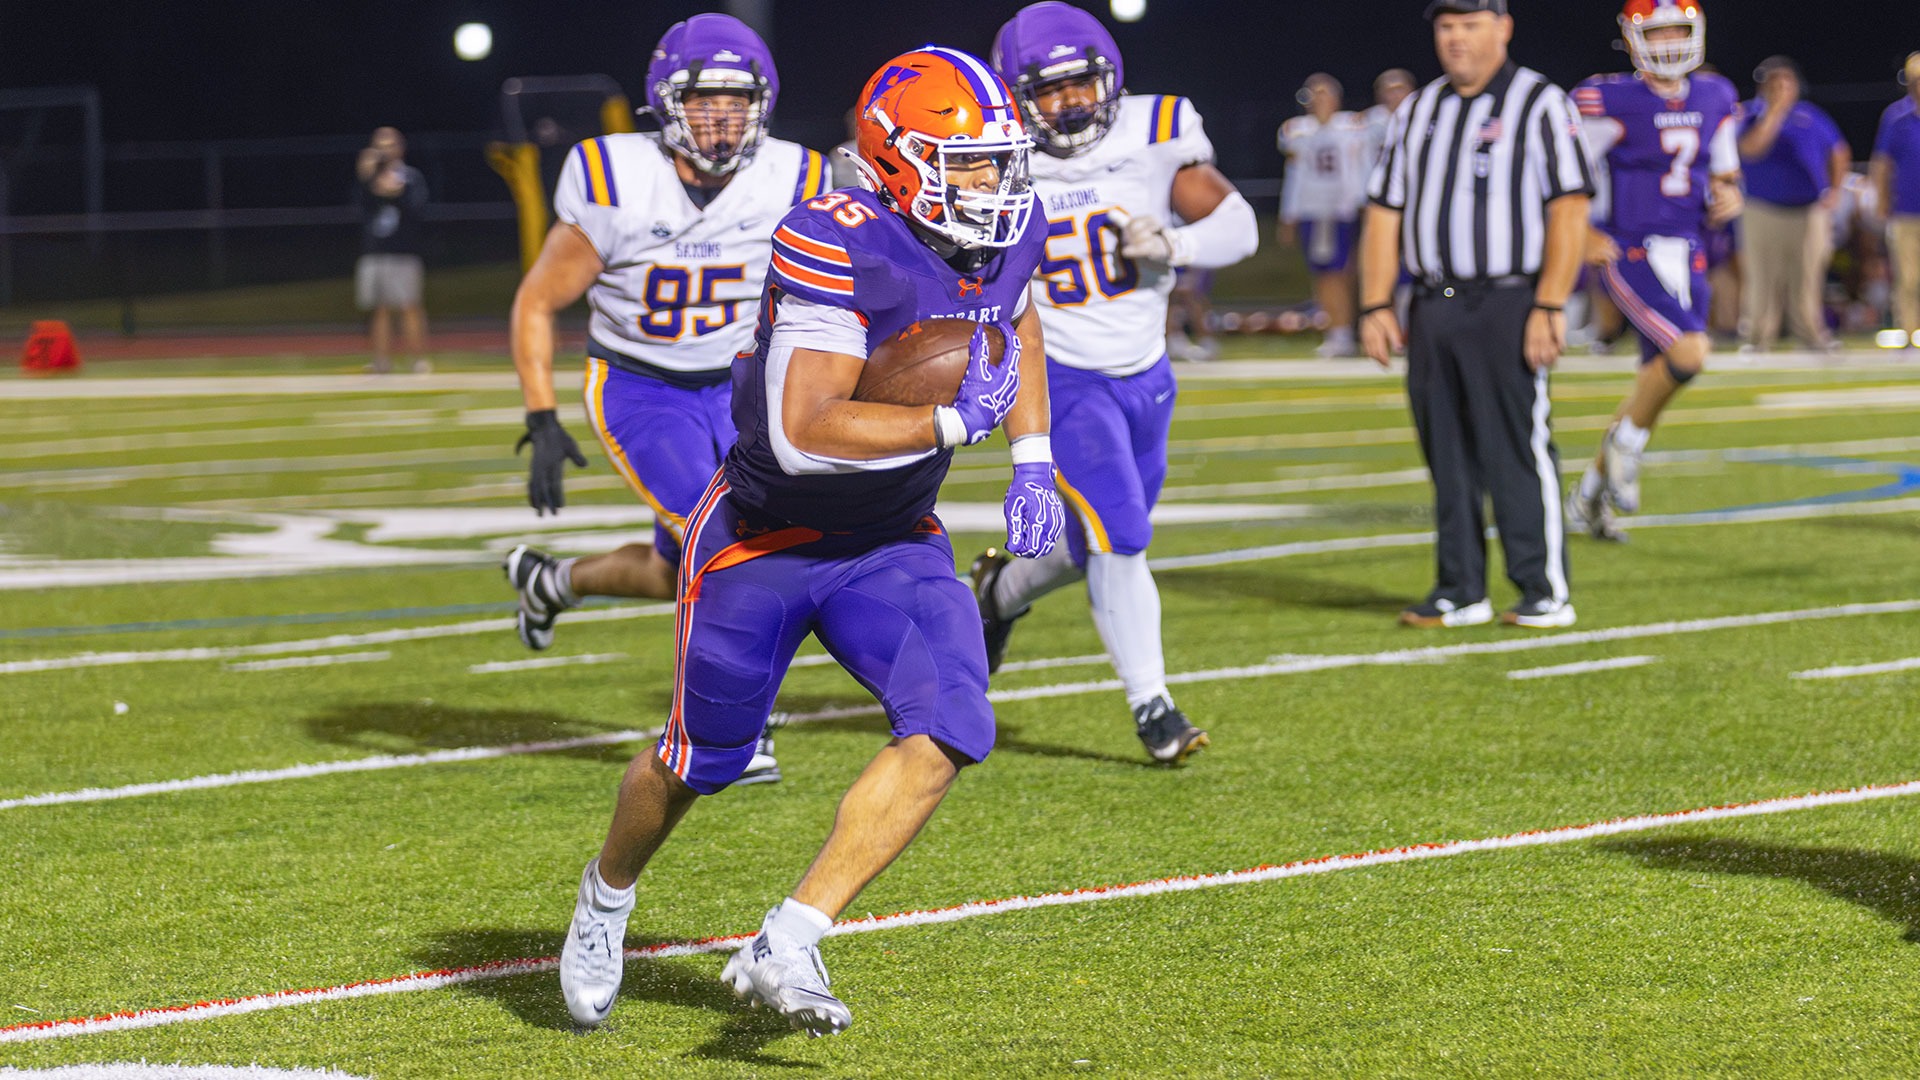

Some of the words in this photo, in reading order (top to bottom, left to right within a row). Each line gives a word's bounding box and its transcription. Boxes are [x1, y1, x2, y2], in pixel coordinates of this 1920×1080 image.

[1660, 127, 1700, 197] 7
[807, 192, 879, 229] 35
[1038, 205, 1138, 309] 50
[930, 305, 1002, 323] ART
